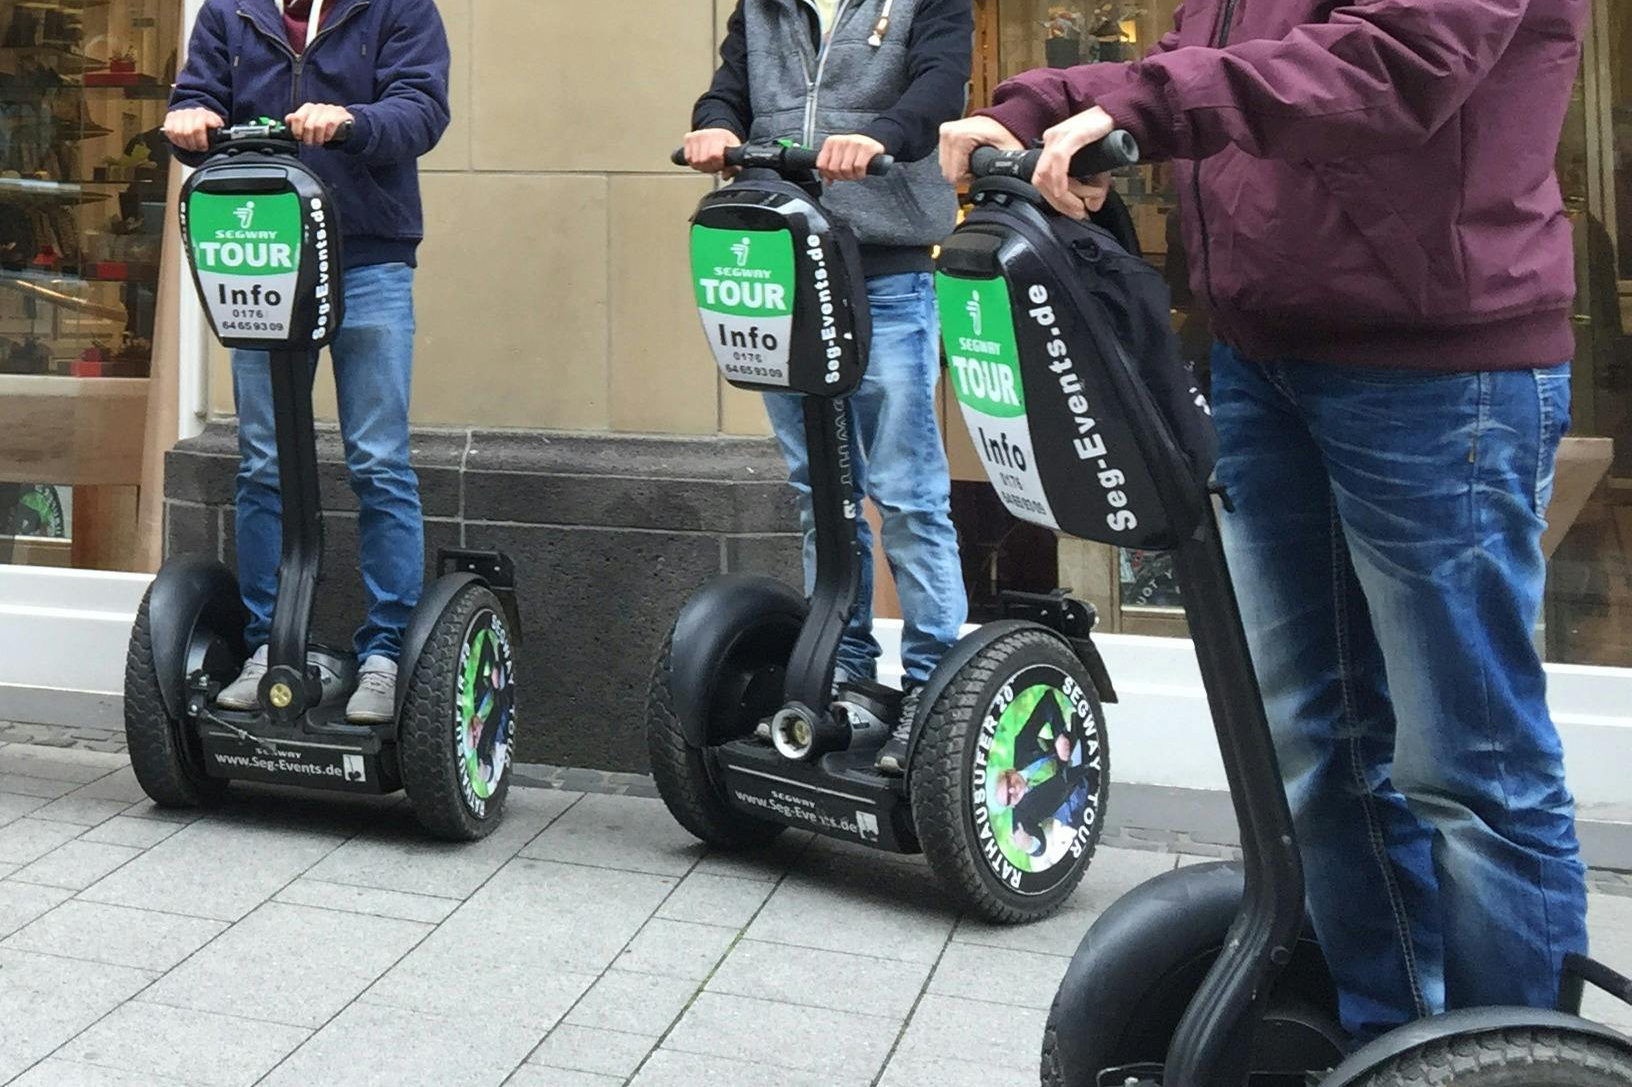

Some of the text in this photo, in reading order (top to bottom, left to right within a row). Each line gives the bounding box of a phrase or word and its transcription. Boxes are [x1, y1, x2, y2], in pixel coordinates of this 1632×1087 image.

[215, 230, 277, 239] SEGWAY
[199, 242, 292, 267] TOUR
[714, 267, 772, 279] SEGWAY
[218, 284, 281, 306] Info
[699, 278, 787, 310] TOUR
[232, 309, 264, 318] 0176
[807, 235, 842, 384] Seg-Events.de
[719, 324, 777, 351] Info
[959, 337, 1002, 356] SEGWAY
[733, 352, 762, 363] 0176
[952, 355, 1020, 407] TOUR
[1028, 284, 1138, 532] Seg-Events.de
[978, 427, 1027, 472] Info
[1062, 676, 1102, 771] SEGWAY
[215, 753, 343, 777] www.Seg-Events.de
[974, 717, 1022, 889] RATHAUSUFER
[1071, 794, 1098, 860] TOUR
